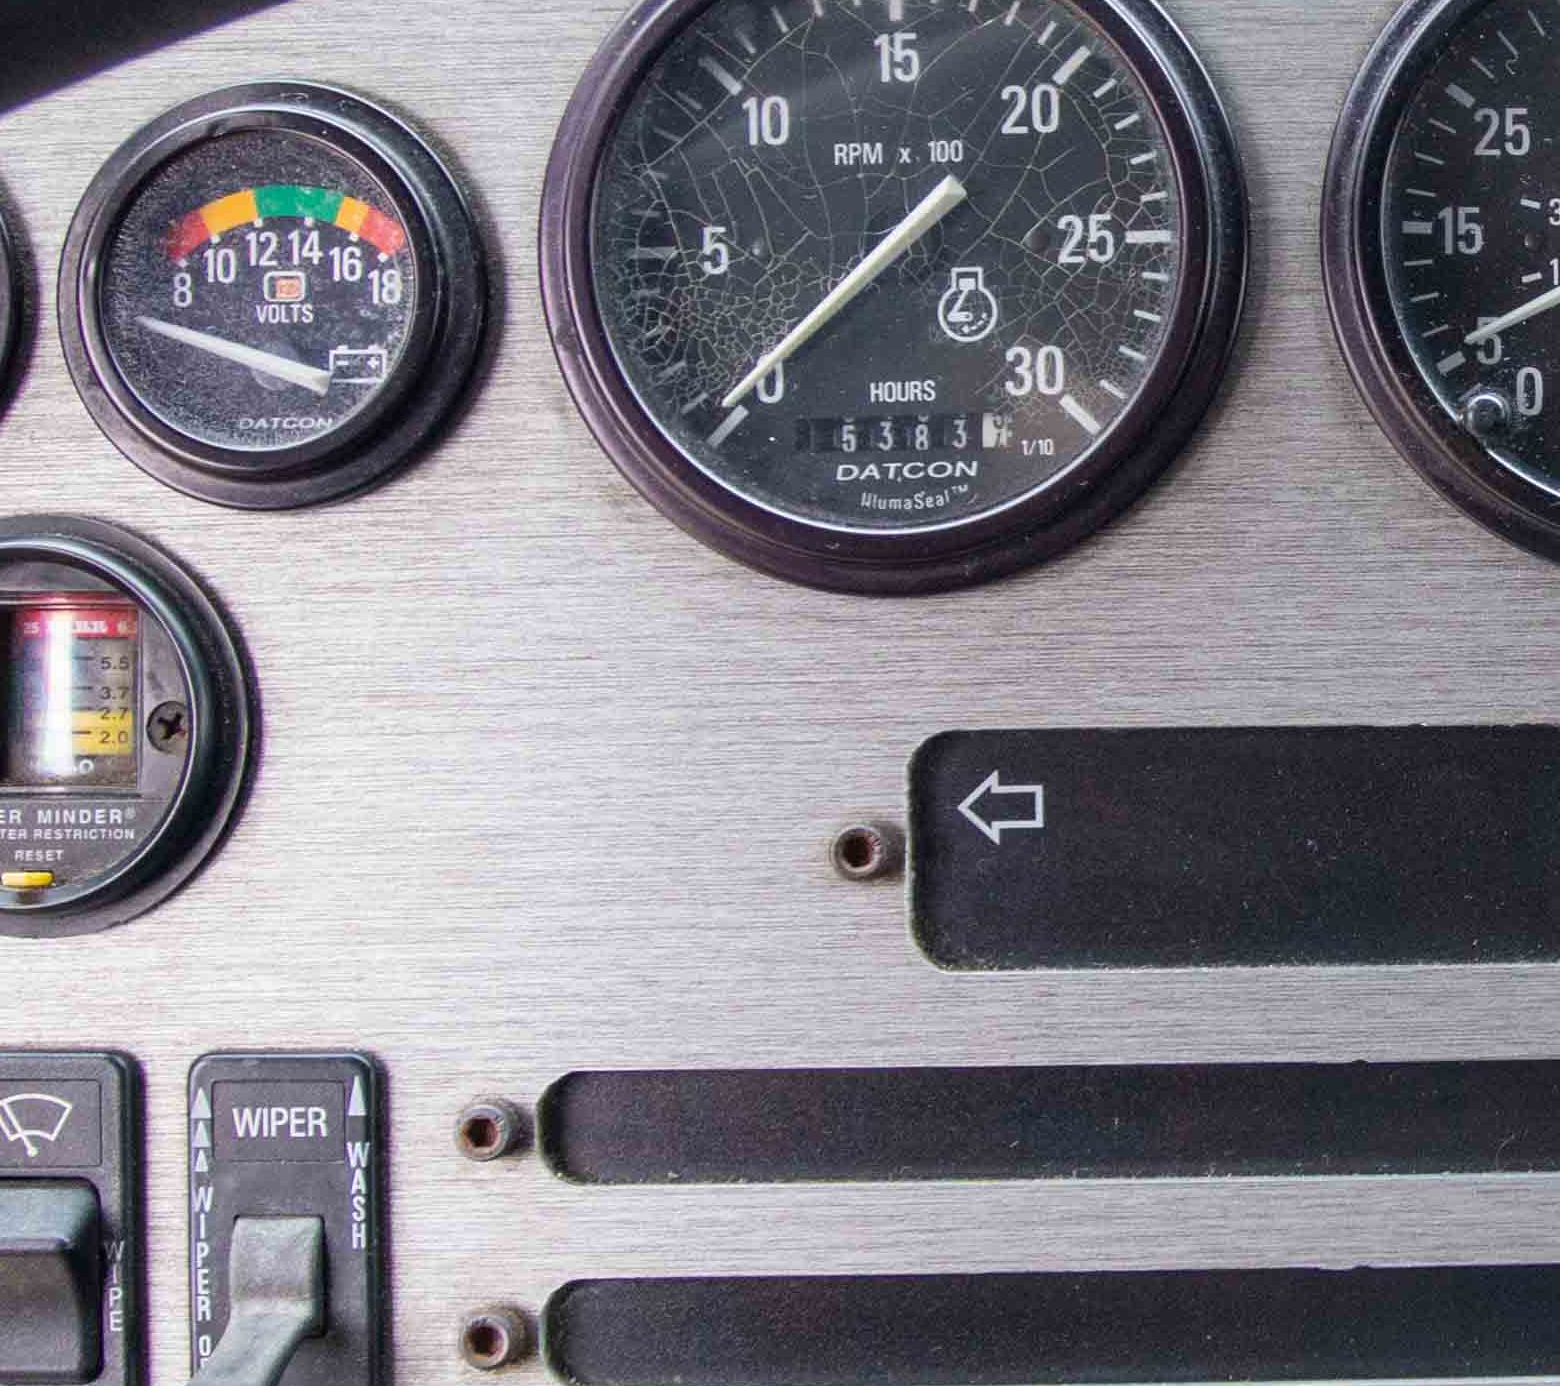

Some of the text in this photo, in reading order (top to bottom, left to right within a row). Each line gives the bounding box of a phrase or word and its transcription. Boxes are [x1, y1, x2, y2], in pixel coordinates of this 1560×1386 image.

[875, 34, 918, 82] 15
[742, 95, 789, 145] 10
[1001, 85, 1059, 134] 20
[1473, 108, 1531, 157] 25
[834, 139, 963, 165] RPM x 100
[288, 230, 322, 265] 14
[1057, 215, 1114, 264] 25
[1439, 206, 1483, 256] 15
[204, 248, 236, 283] 10
[246, 233, 278, 267] 12
[329, 247, 363, 281] 16
[702, 227, 729, 275] 5
[173, 273, 192, 307] 8
[368, 270, 402, 305] 18
[256, 304, 314, 324] VOLTS
[756, 356, 784, 403] 0
[1005, 346, 1065, 396] 30
[870, 381, 936, 403] HOURS
[1515, 366, 1544, 415] 0
[239, 417, 334, 430] DATCON
[1021, 438, 1054, 456] 1/10
[836, 461, 978, 481] DATCON
[100, 686, 129, 700] 3.7
[99, 707, 129, 721] 2.7
[99, 730, 129, 744] 2.0
[32, 828, 135, 840] RESTRICTION
[14, 849, 64, 861] RESET
[233, 1107, 327, 1138] WIPER
[347, 1142, 369, 1249] WASH
[193, 1187, 213, 1322] WIPER
[105, 1242, 125, 1333] WIPE
